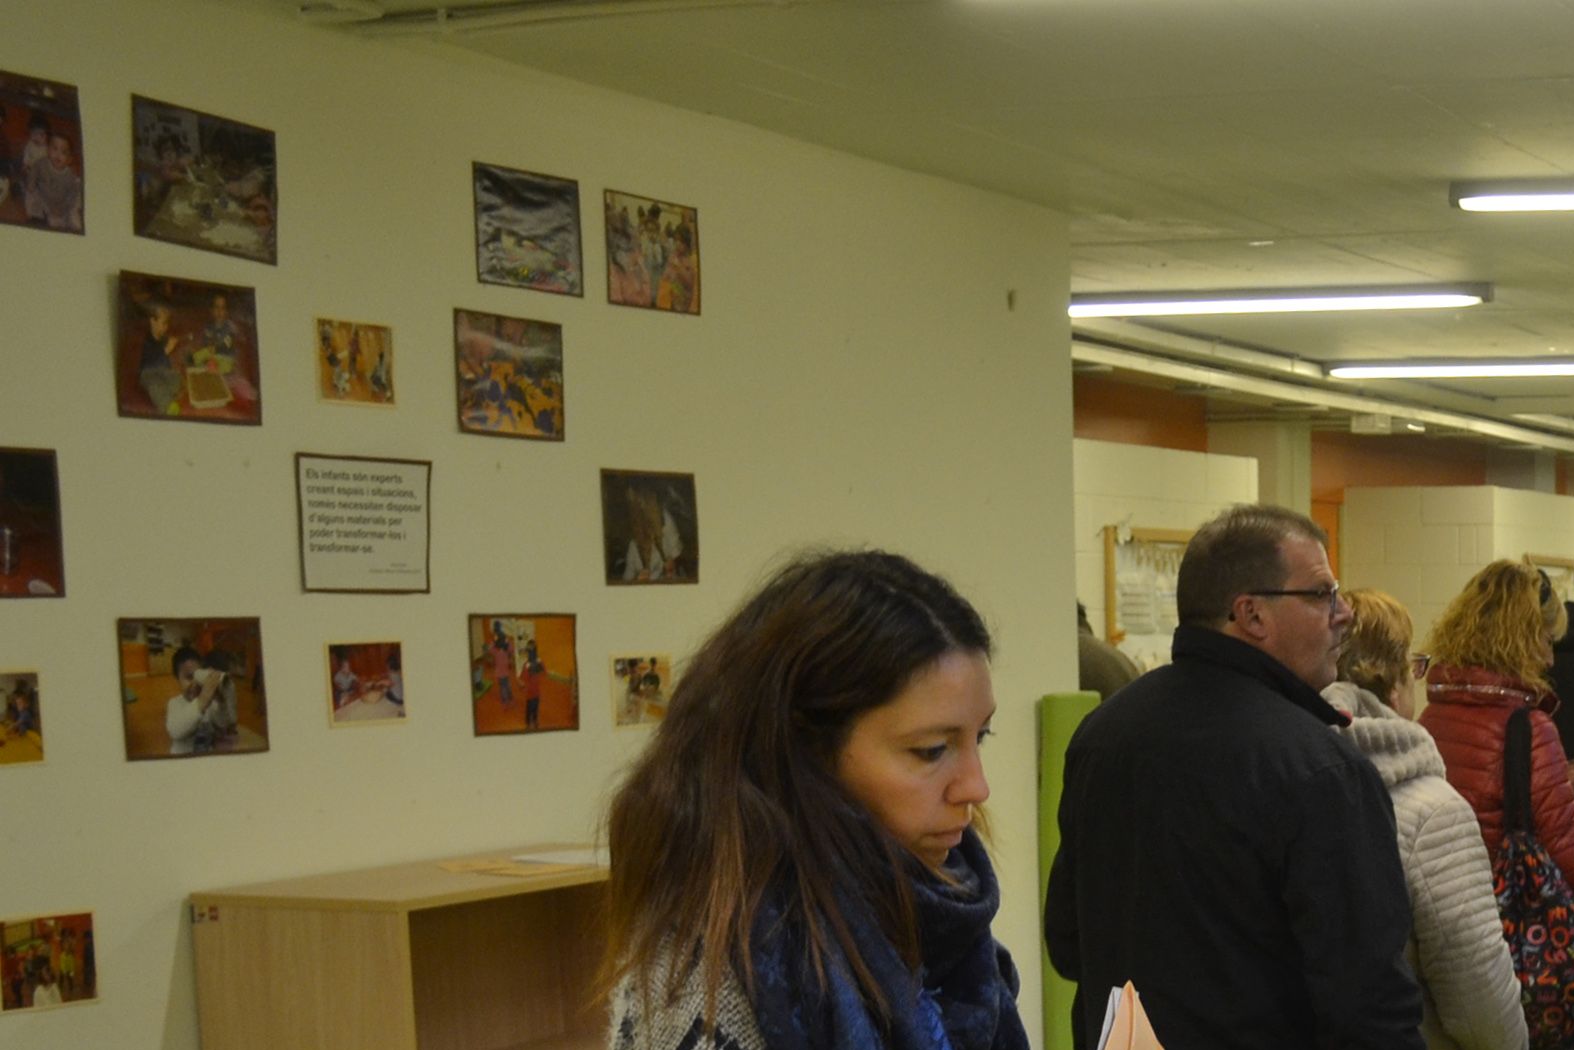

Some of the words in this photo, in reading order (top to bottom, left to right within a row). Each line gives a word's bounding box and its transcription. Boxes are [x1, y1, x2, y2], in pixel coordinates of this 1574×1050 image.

[306, 468, 319, 480] Els
[321, 469, 350, 480] infants
[352, 471, 368, 482] són
[370, 473, 403, 484] experts
[306, 484, 334, 495] creant
[337, 486, 364, 498] espais
[386, 502, 422, 514] disposar
[346, 515, 386, 526] materials
[388, 518, 402, 527] per
[309, 528, 334, 540] poder
